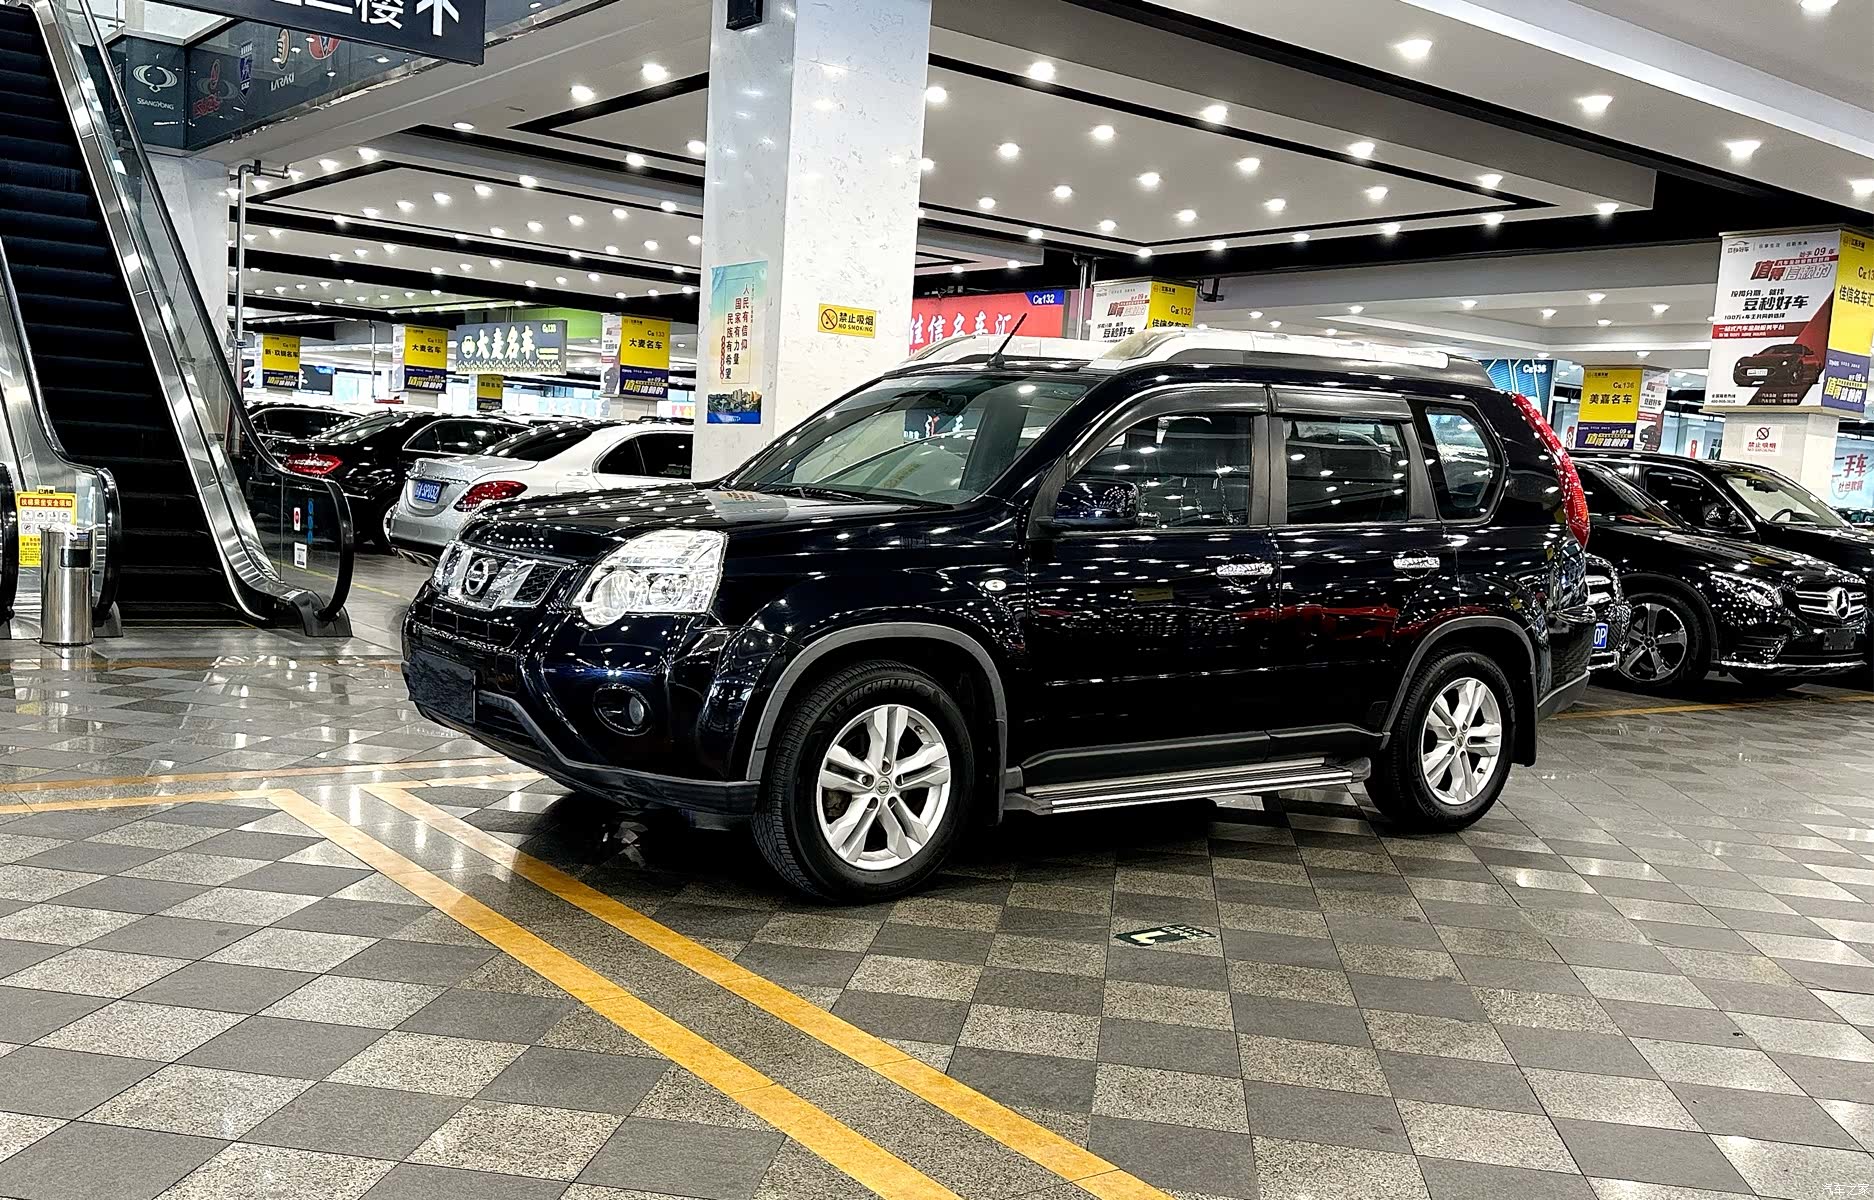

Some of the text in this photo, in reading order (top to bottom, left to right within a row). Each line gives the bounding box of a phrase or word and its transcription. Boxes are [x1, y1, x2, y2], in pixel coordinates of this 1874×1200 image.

[136, 97, 175, 110] SSANGYONG
[1742, 295, 1809, 312] 豆秒好车
[839, 312, 874, 326] 禁止吸烟
[733, 298, 742, 365] 国家有力量
[848, 324, 873, 333] SMOKING
[629, 338, 663, 350] 大麦名车
[725, 313, 734, 380] 民族有希望
[1589, 394, 1633, 405] 美嘉名车
[846, 679, 915, 707] MICHELIN
